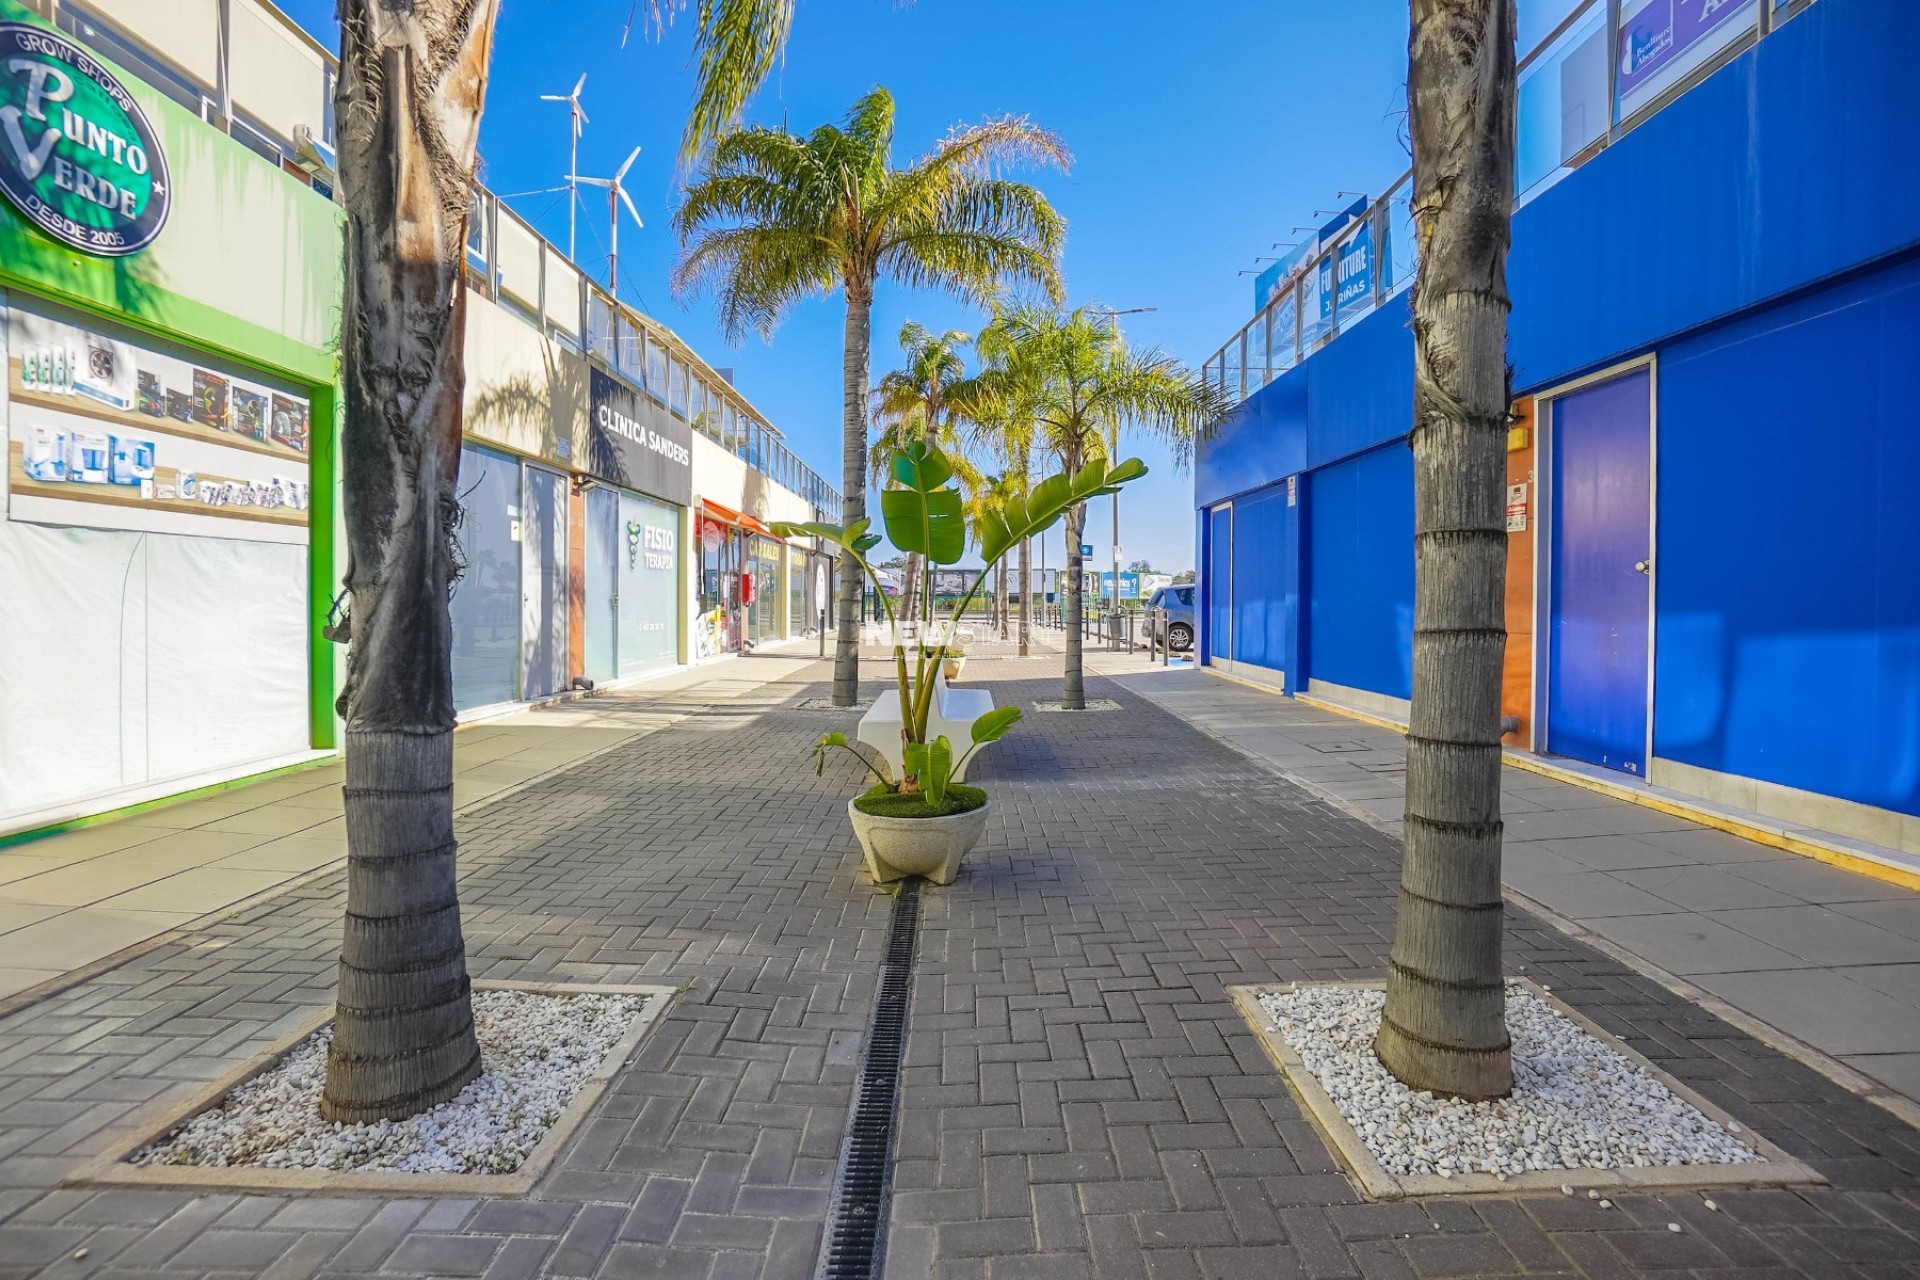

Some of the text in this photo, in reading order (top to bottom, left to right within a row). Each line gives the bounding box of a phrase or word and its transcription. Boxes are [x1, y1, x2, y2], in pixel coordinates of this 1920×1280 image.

[15, 32, 73, 63] GROW
[77, 56, 132, 112] SHOPS
[9, 58, 148, 175] PUNTO
[0, 104, 136, 221] VERDE
[25, 194, 125, 246] DESDE 2005
[1320, 245, 1366, 295] FUITURE
[599, 404, 689, 467] CLINICA SANDERS
[644, 524, 674, 552] FISIO
[644, 551, 674, 571] TERAPIA
